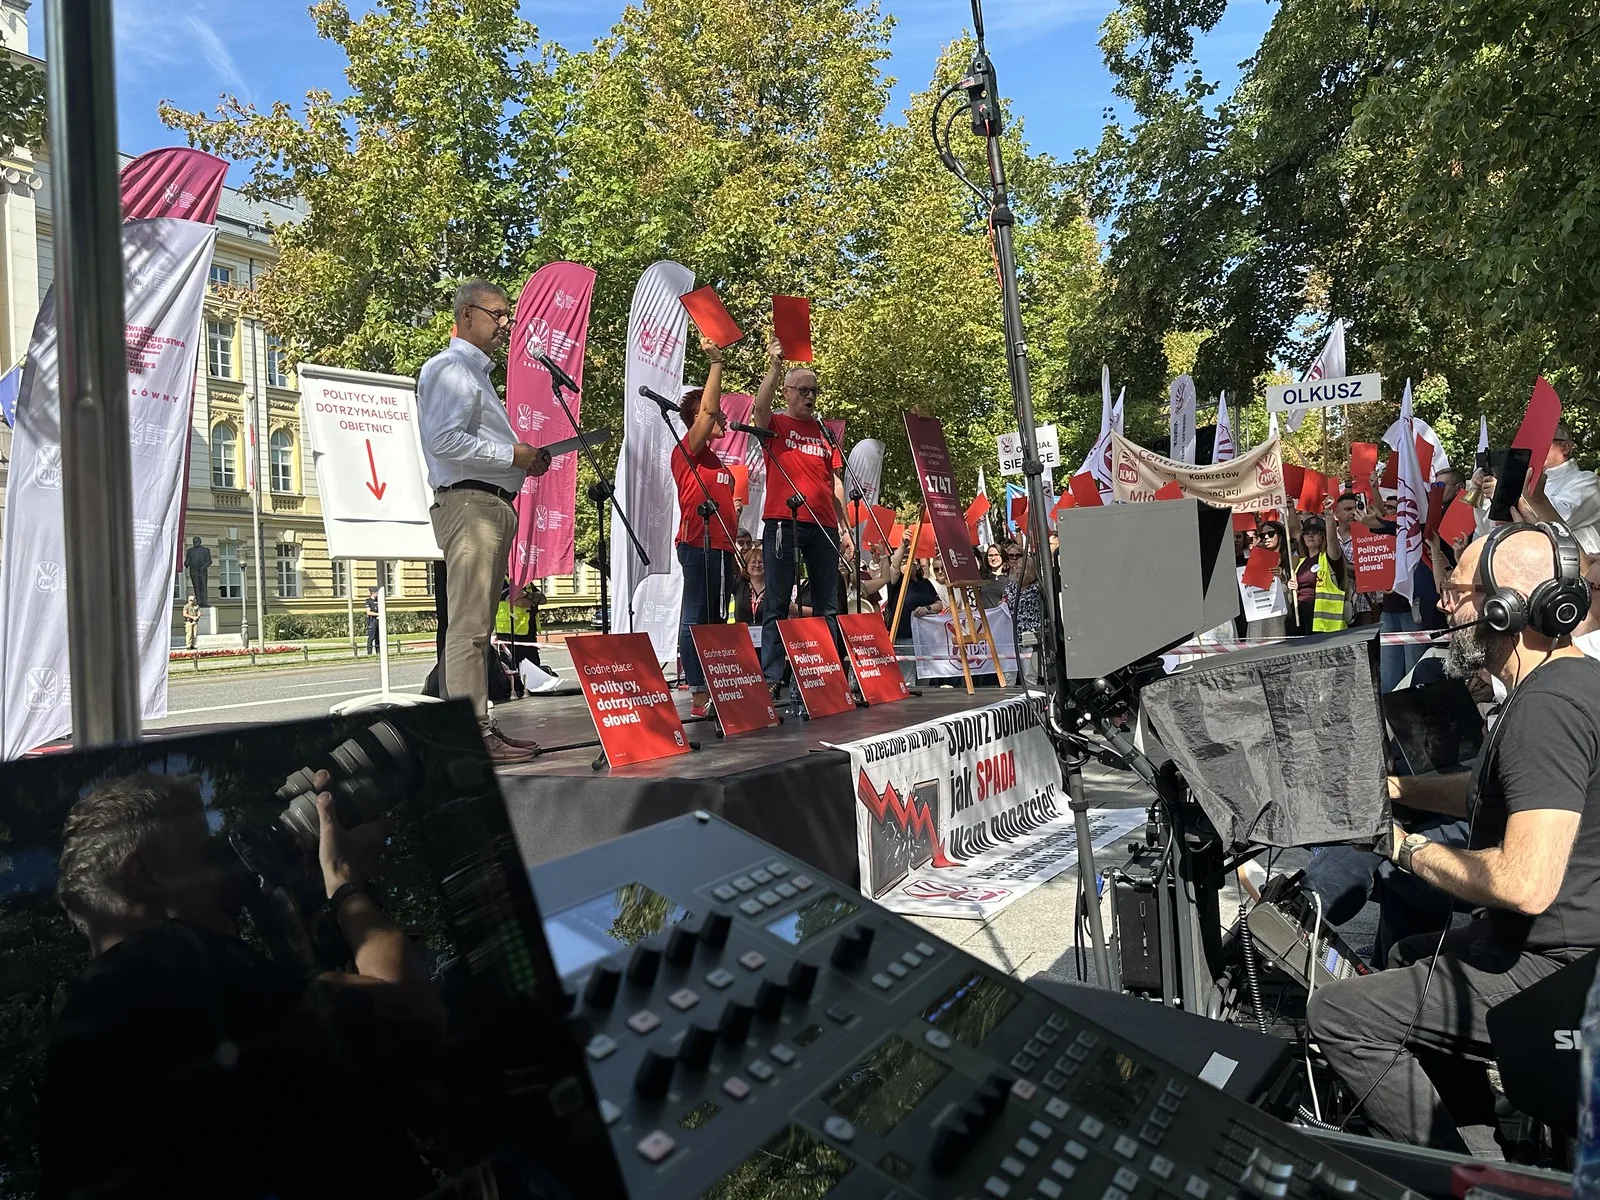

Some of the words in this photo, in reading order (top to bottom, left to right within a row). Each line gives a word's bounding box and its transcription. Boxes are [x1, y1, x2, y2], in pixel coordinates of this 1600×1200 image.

[126, 339, 163, 350] OLSKIEGO
[126, 351, 145, 361] OLISH
[131, 388, 179, 403] ŁÓWNY
[323, 389, 379, 405] POLITYCY,
[380, 396, 398, 406] NIE
[1283, 381, 1362, 405] OLKUSZ
[316, 402, 410, 421] DOTRZYMALIŚCIE
[339, 420, 393, 434] OBIETNIC!
[1016, 440, 1053, 453] OIAŁ
[1003, 452, 1054, 470] SIECE
[1119, 469, 1138, 481] KMN
[1188, 471, 1240, 480] Konkretów
[1260, 471, 1275, 484] ZNP
[925, 474, 952, 494] 1747
[1356, 536, 1373, 544] Godne
[1357, 544, 1389, 555] Politycy,
[1358, 551, 1395, 563] dotrzymaj
[1359, 562, 1384, 572] słowa!
[703, 649, 723, 659] Godne
[852, 646, 880, 656] Politycy,
[794, 652, 824, 665] Politycy,
[856, 654, 896, 668] dotrzymajcie
[584, 663, 611, 676] Godne
[611, 661, 634, 675] płace:
[708, 663, 743, 675] Politycy,
[799, 662, 841, 677] dotrzymajcie
[860, 667, 881, 679] słowa!
[590, 679, 641, 696] Politycy,
[713, 673, 763, 689] dotrzymajcie
[803, 677, 825, 689] słowa!
[597, 690, 668, 712] dotrzymajcie
[717, 689, 744, 702] słowa!
[602, 710, 641, 728] słowa!
[950, 766, 973, 818] jak
[976, 750, 1017, 802] SPADA
[949, 820, 999, 861] Wam
